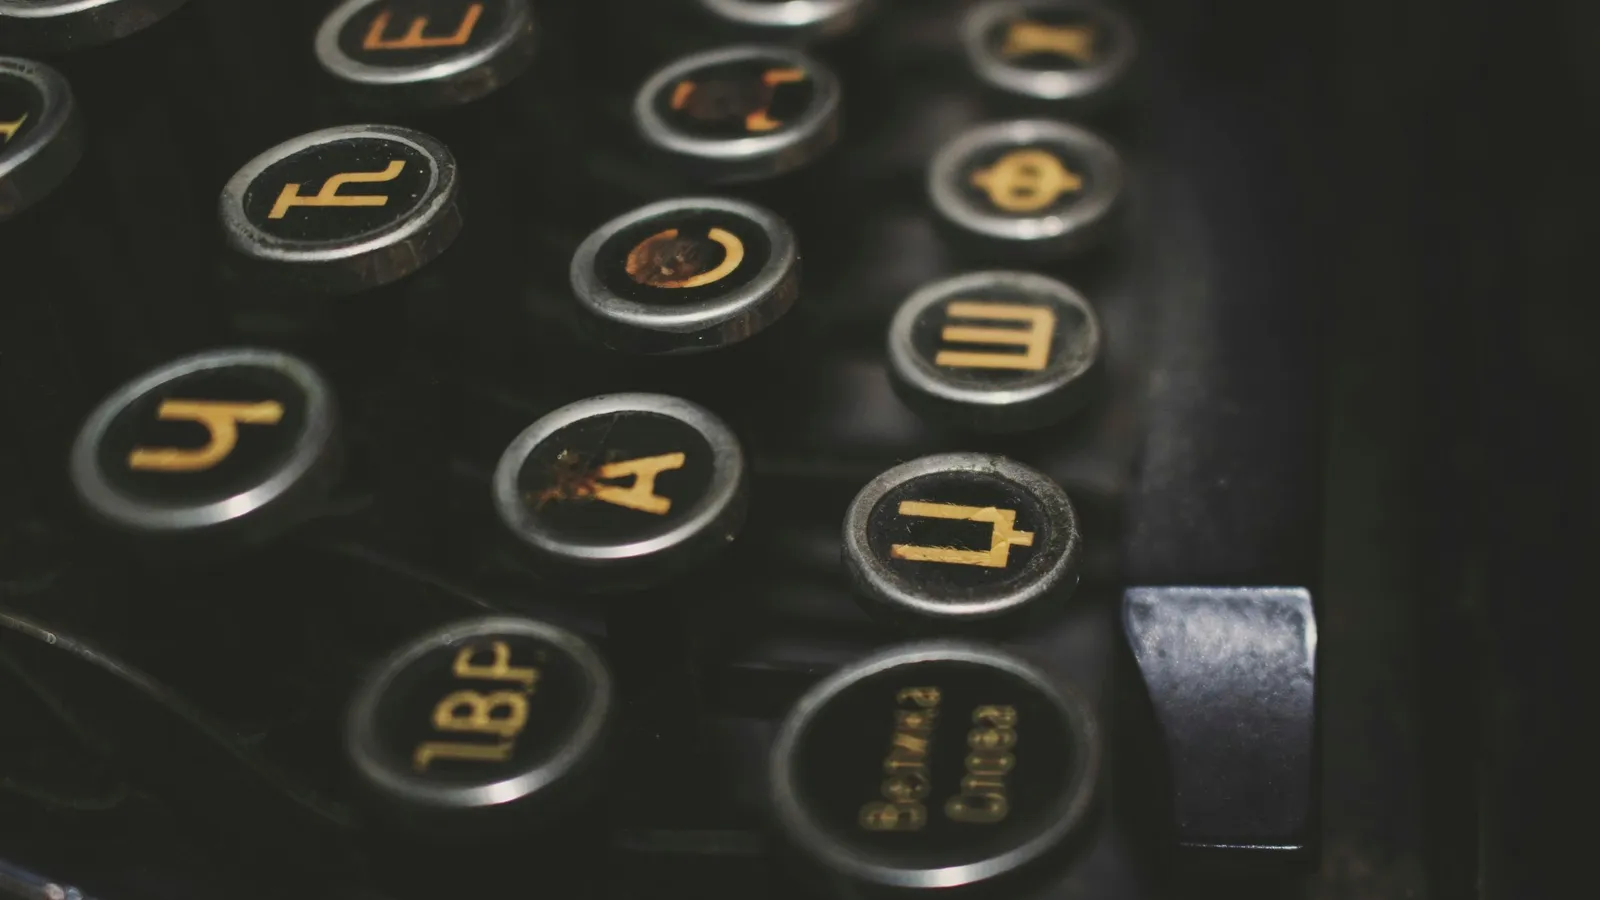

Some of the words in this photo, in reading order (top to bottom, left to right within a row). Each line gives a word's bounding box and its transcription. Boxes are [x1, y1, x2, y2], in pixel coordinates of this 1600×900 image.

[363, 3, 484, 50] Е
[970, 149, 1083, 213] Ф
[935, 301, 1057, 371] Ш
[129, 398, 284, 470] Ч
[574, 450, 686, 515] А
[890, 499, 1035, 569] Ц
